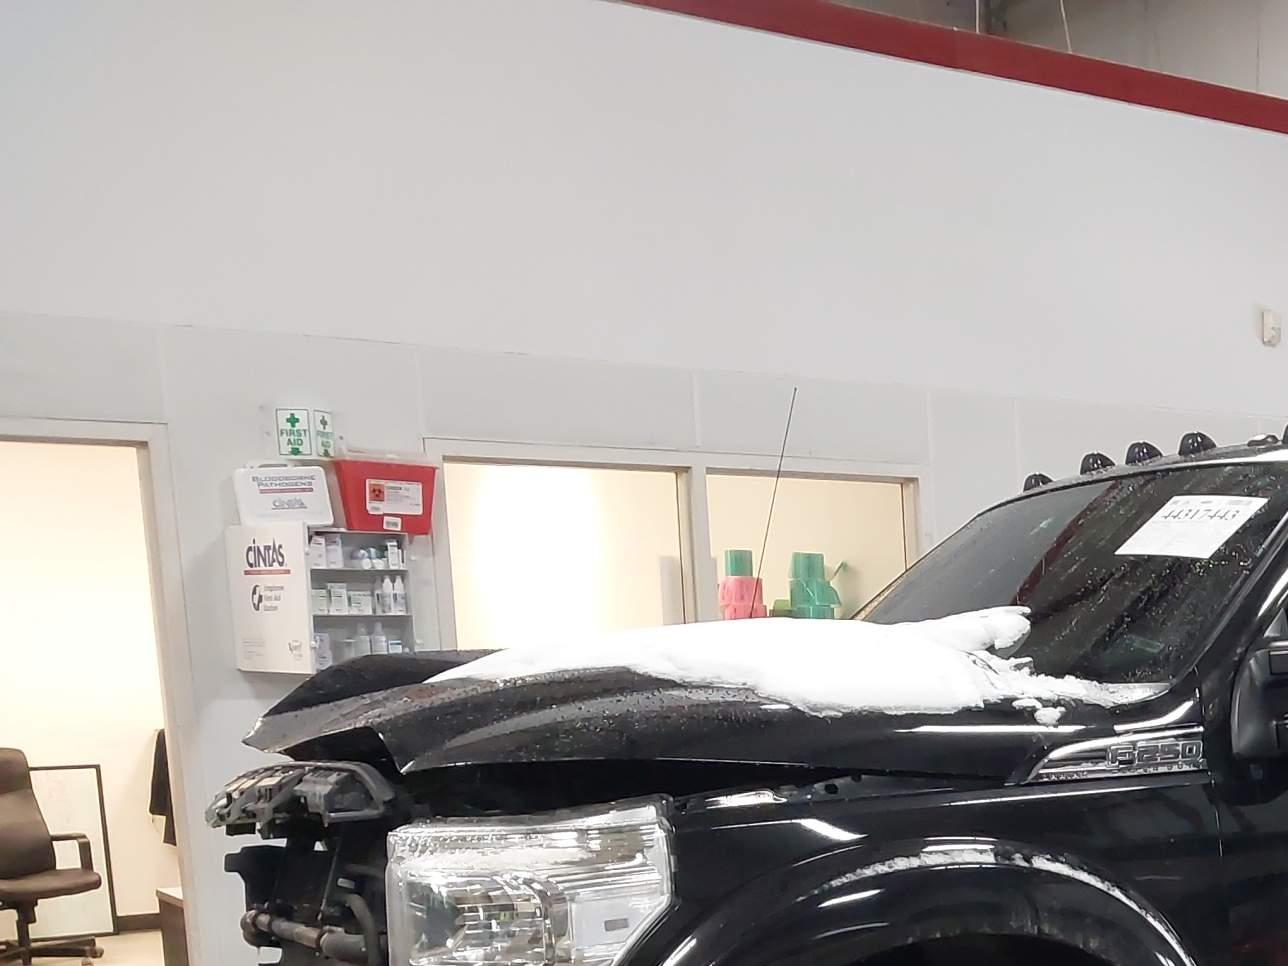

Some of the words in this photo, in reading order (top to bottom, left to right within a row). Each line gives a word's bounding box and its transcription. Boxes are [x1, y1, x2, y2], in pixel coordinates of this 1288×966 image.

[280, 429, 307, 437] FIRST
[287, 438, 304, 446] AID
[1161, 509, 1240, 521] 44317443
